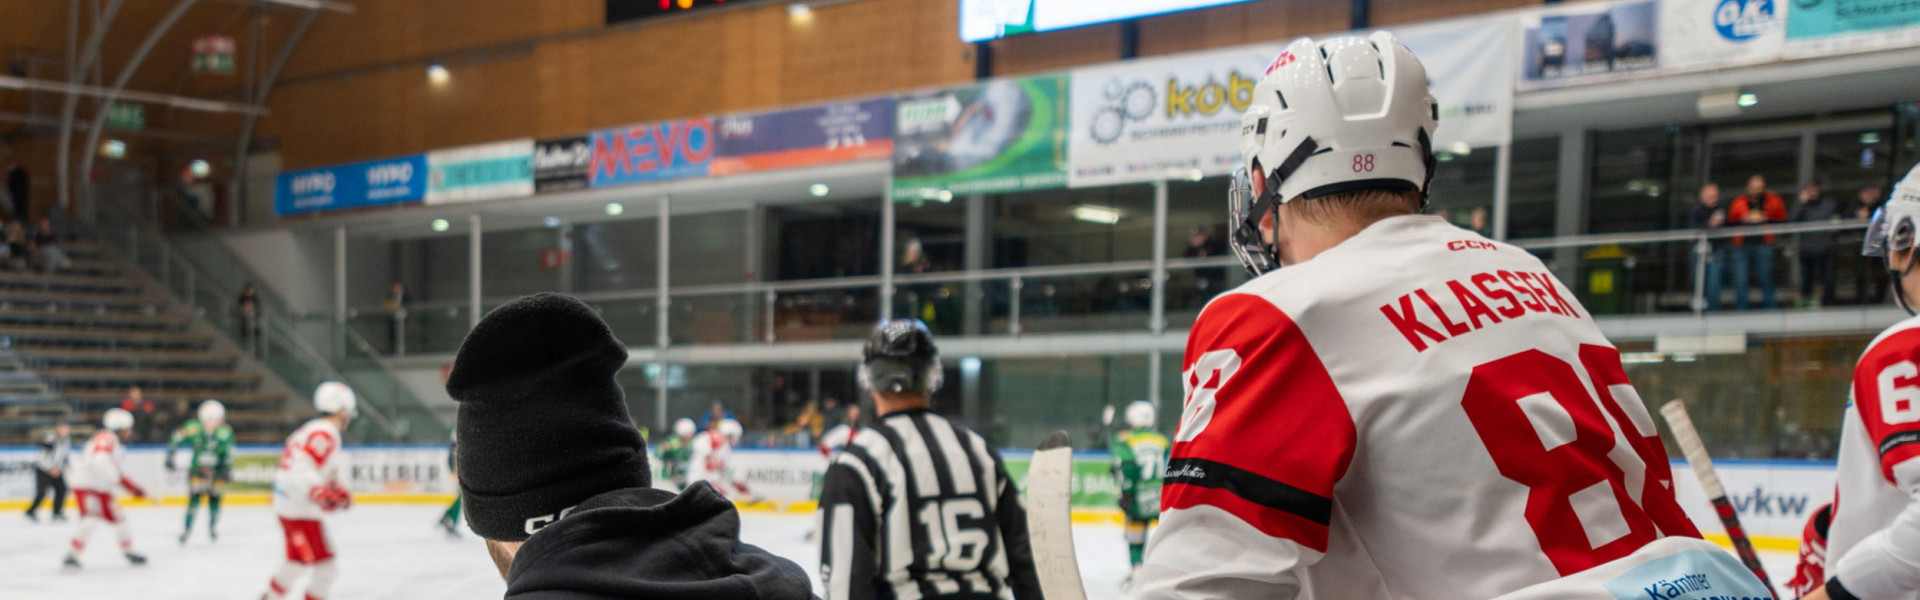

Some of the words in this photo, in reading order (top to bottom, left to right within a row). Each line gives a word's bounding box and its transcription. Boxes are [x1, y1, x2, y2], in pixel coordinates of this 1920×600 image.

[588, 117, 714, 180] MEVO
[1351, 153, 1376, 174] 88
[1446, 239, 1498, 252] CCM
[352, 464, 441, 482] KLEBER
[1732, 486, 1808, 516] vkw
[919, 497, 990, 571] 16
[1644, 573, 1712, 600] Kärntner
